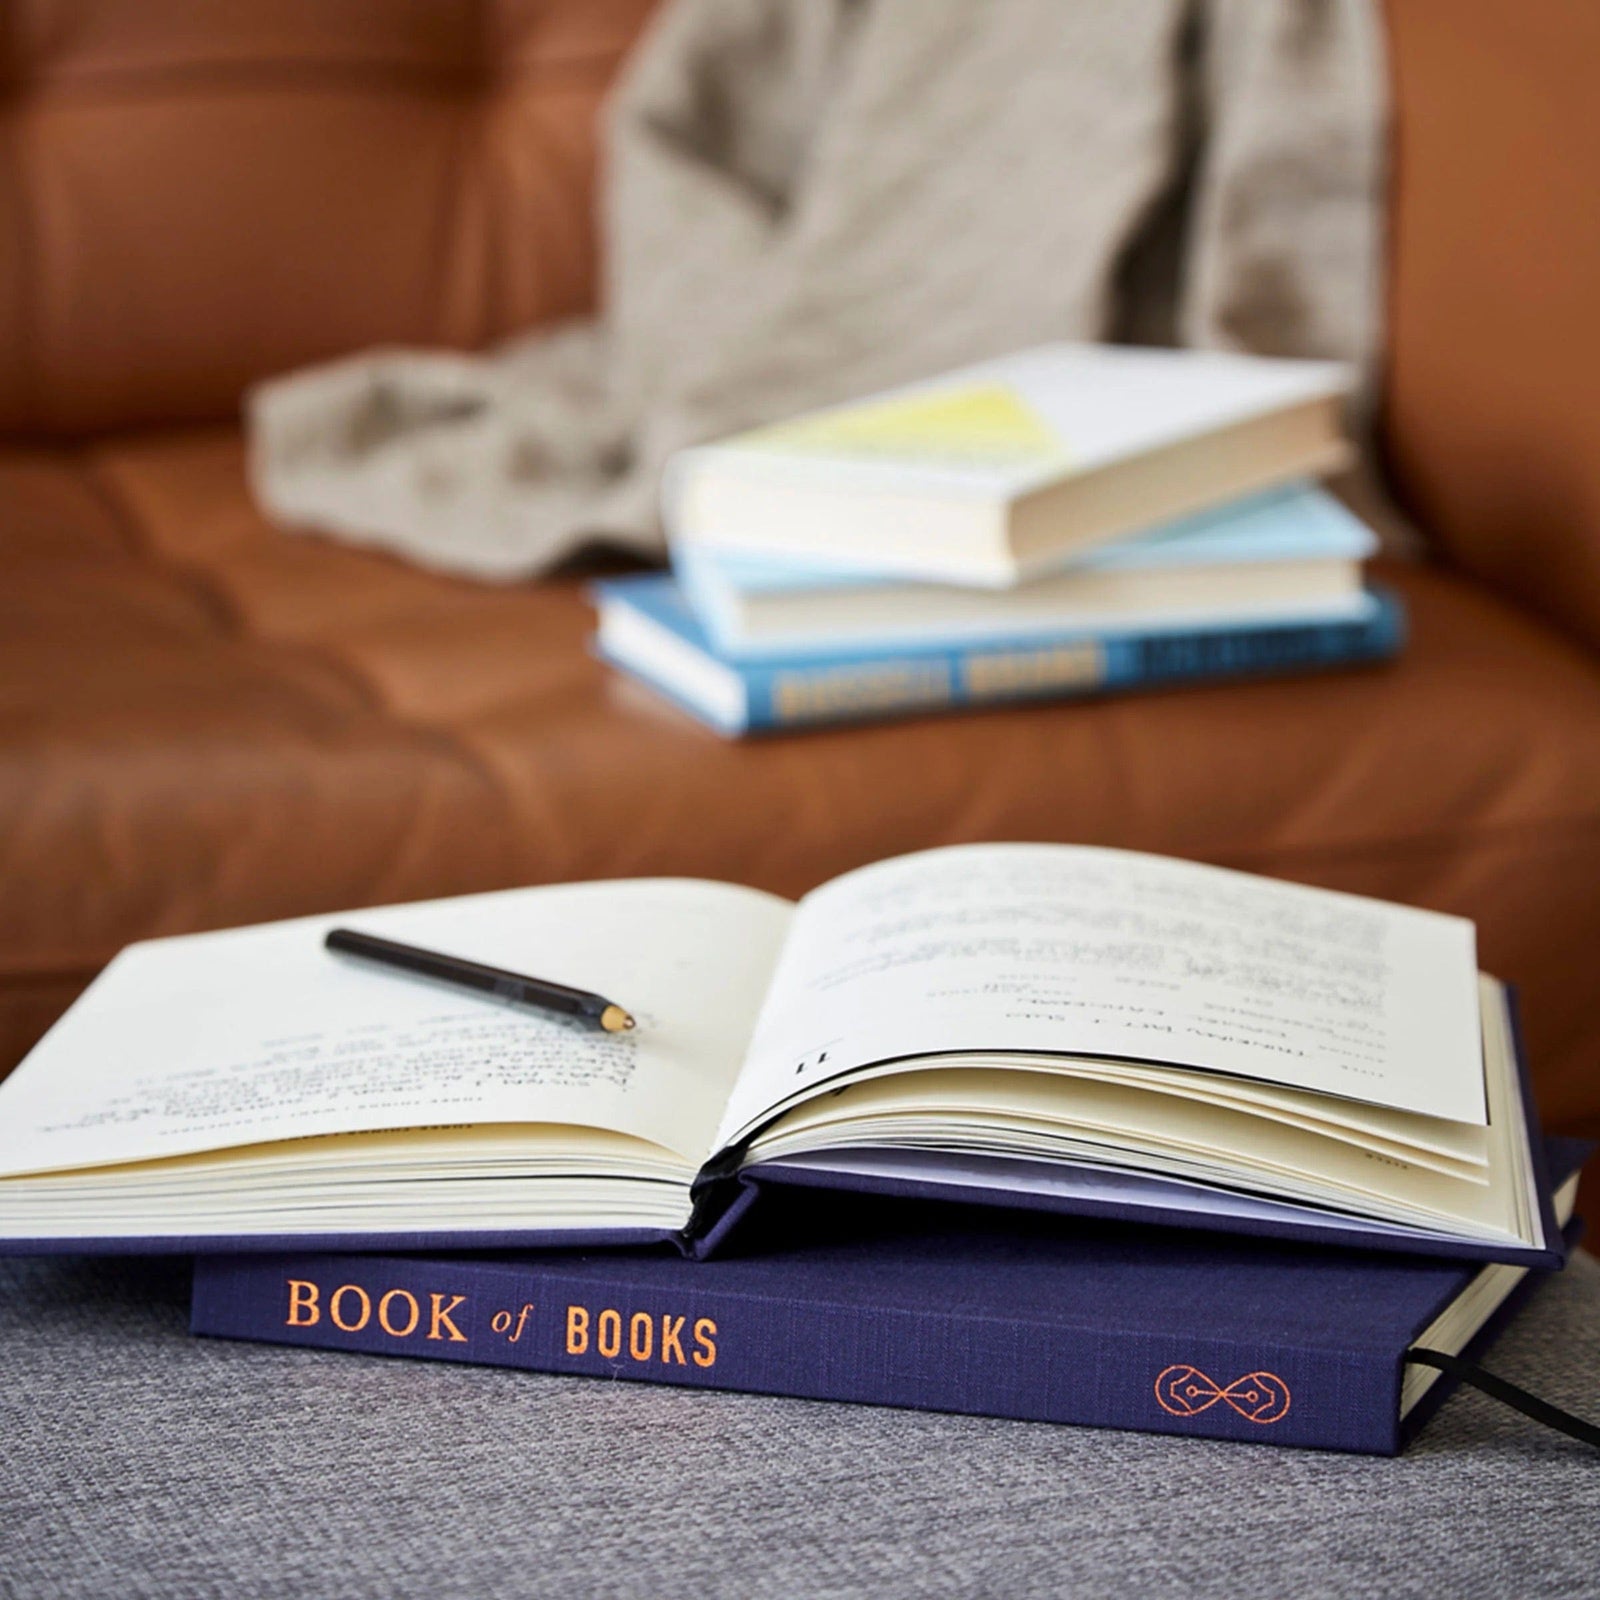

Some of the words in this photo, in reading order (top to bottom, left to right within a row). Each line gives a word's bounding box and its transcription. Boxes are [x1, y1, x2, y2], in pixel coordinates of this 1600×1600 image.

[795, 1051, 831, 1075] 11
[286, 1279, 468, 1343] BOOK
[490, 1303, 534, 1343] of
[566, 1305, 718, 1369] BOOKS
